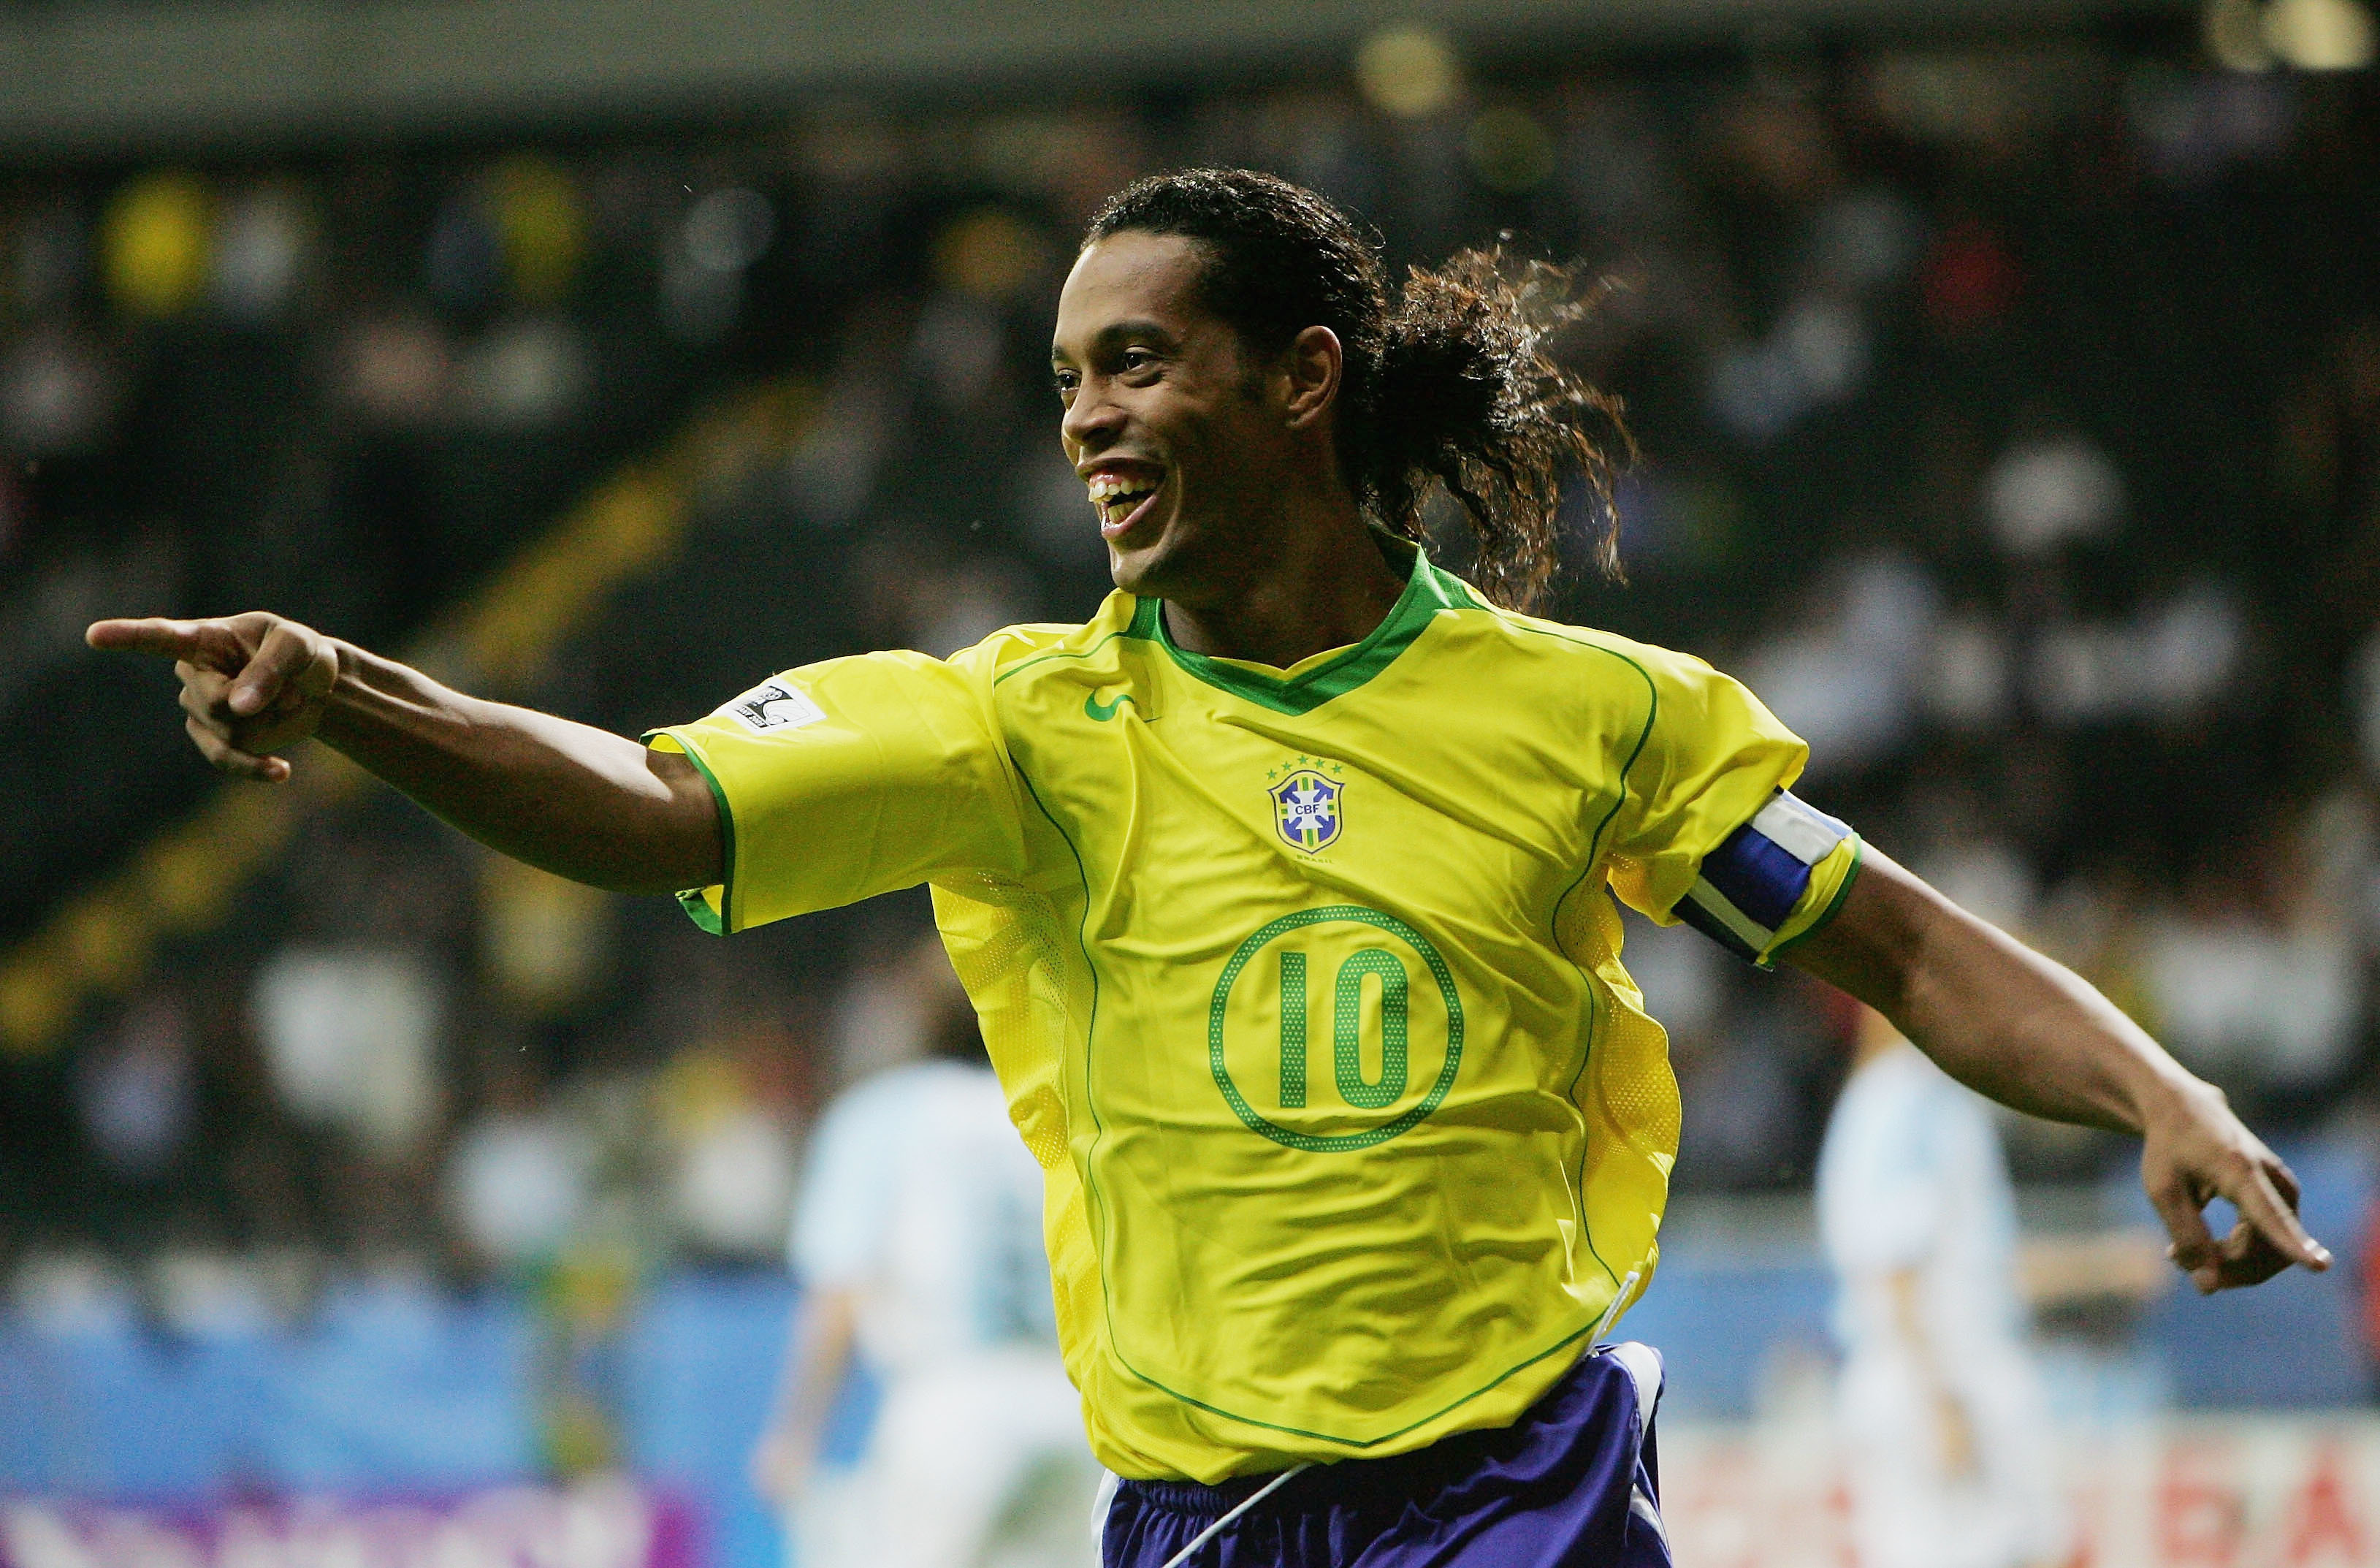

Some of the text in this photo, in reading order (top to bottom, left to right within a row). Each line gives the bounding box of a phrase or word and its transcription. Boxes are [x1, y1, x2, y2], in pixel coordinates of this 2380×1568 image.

[1295, 804, 1320, 815] CBF
[1297, 854, 1334, 864] BRASIL
[1280, 948, 1408, 1109] 10
